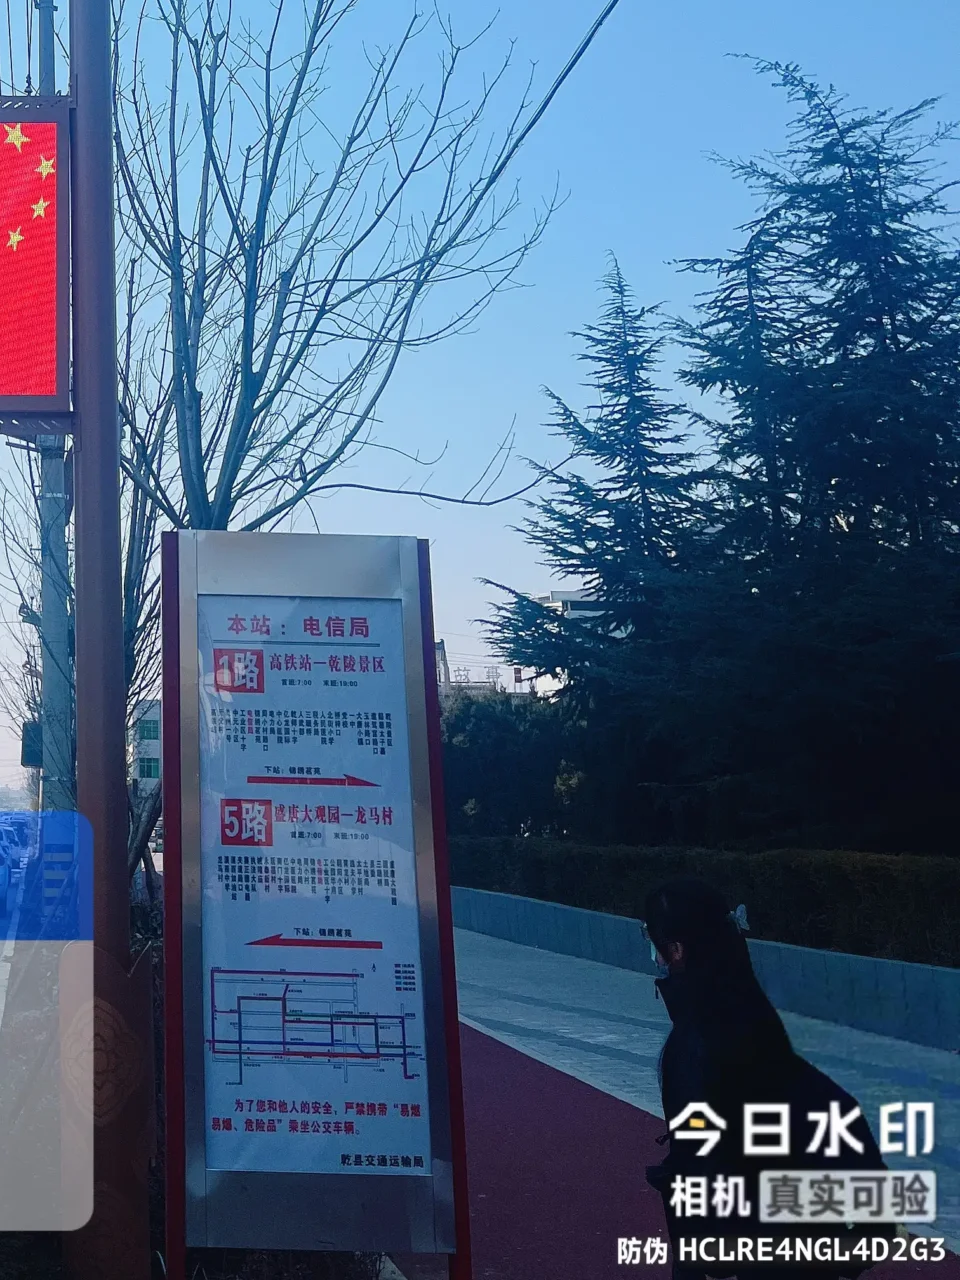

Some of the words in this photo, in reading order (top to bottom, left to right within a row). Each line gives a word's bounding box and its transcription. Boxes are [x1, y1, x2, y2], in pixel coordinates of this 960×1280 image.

[303, 615, 370, 639] 电信局
[219, 651, 260, 690] 1路
[224, 801, 268, 843] 5路
[340, 1153, 425, 1169] 乾县交通运输局
